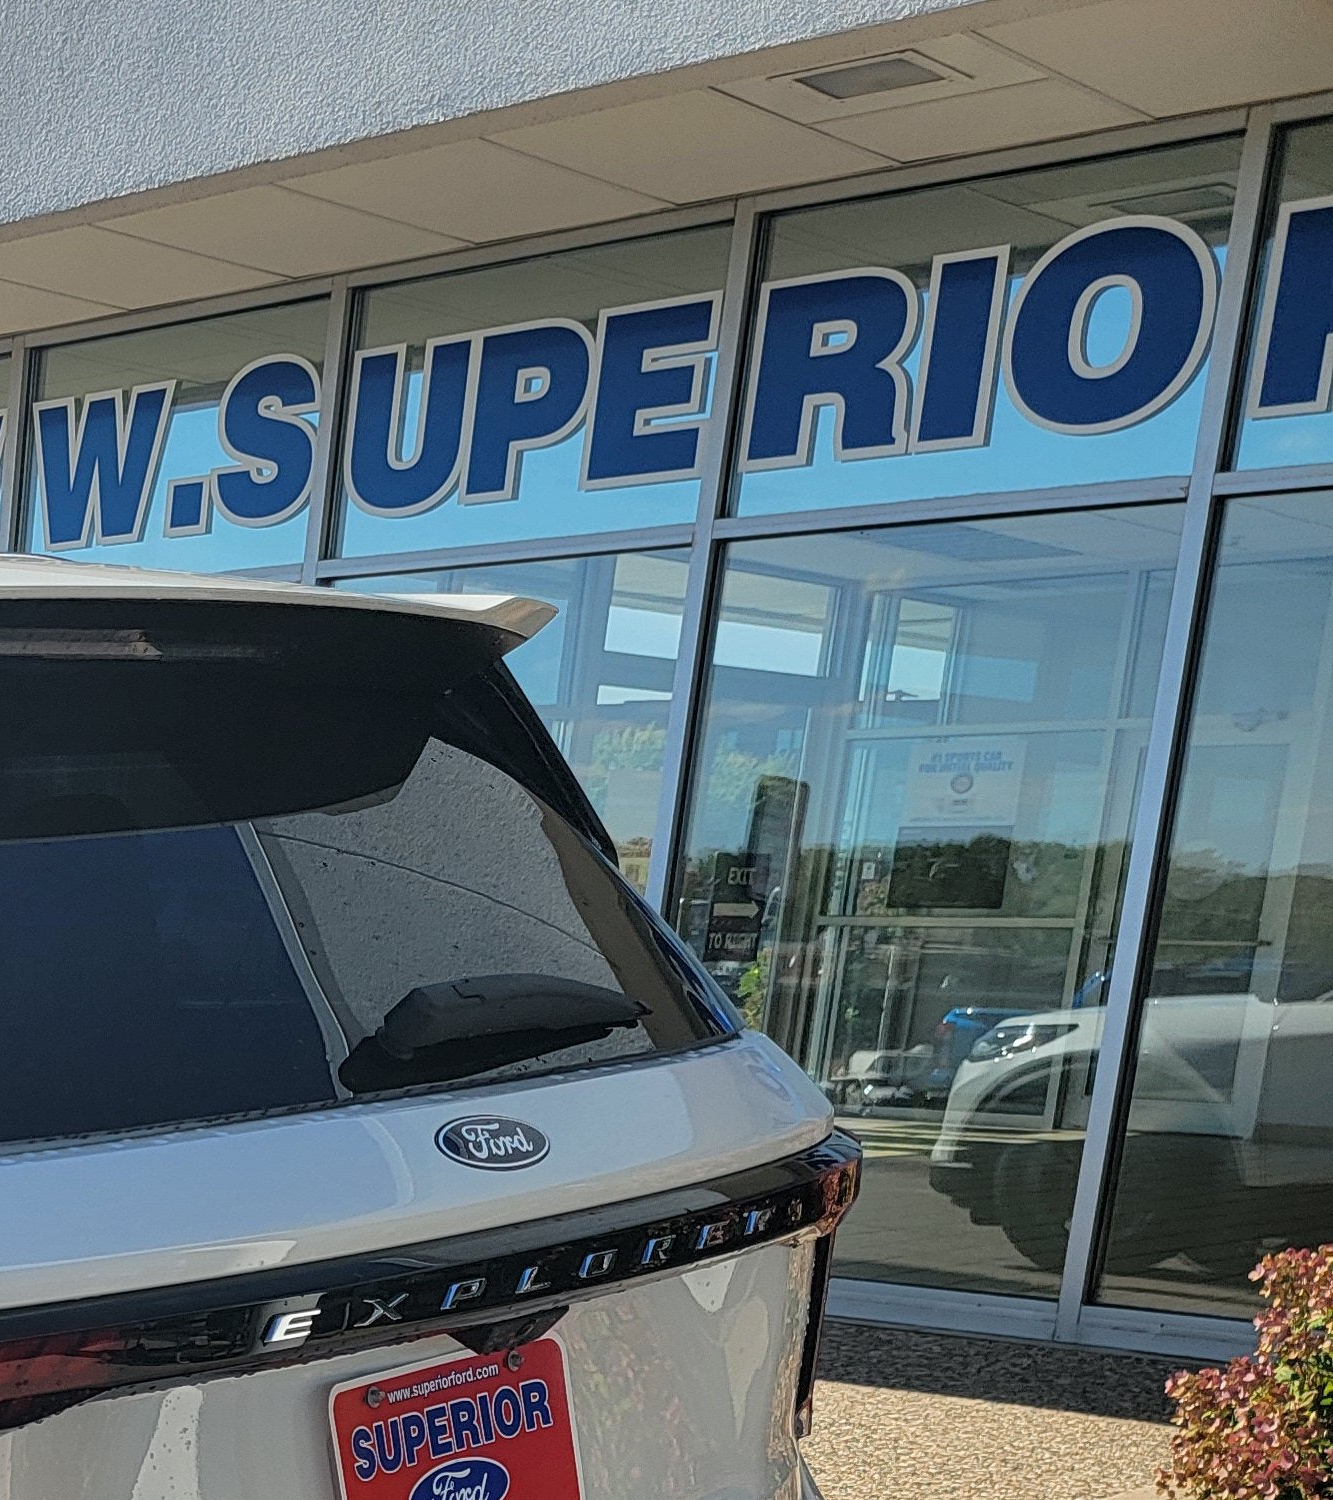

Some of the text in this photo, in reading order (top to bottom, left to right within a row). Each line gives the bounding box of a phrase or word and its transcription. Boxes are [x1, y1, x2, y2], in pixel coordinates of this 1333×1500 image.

[727, 866, 757, 885] EXIT
[708, 932, 758, 950] TO RIGHT
[460, 1124, 533, 1162] Ford
[386, 1362, 500, 1404] www.superiorford.com
[351, 1378, 554, 1482] SUPERIOR
